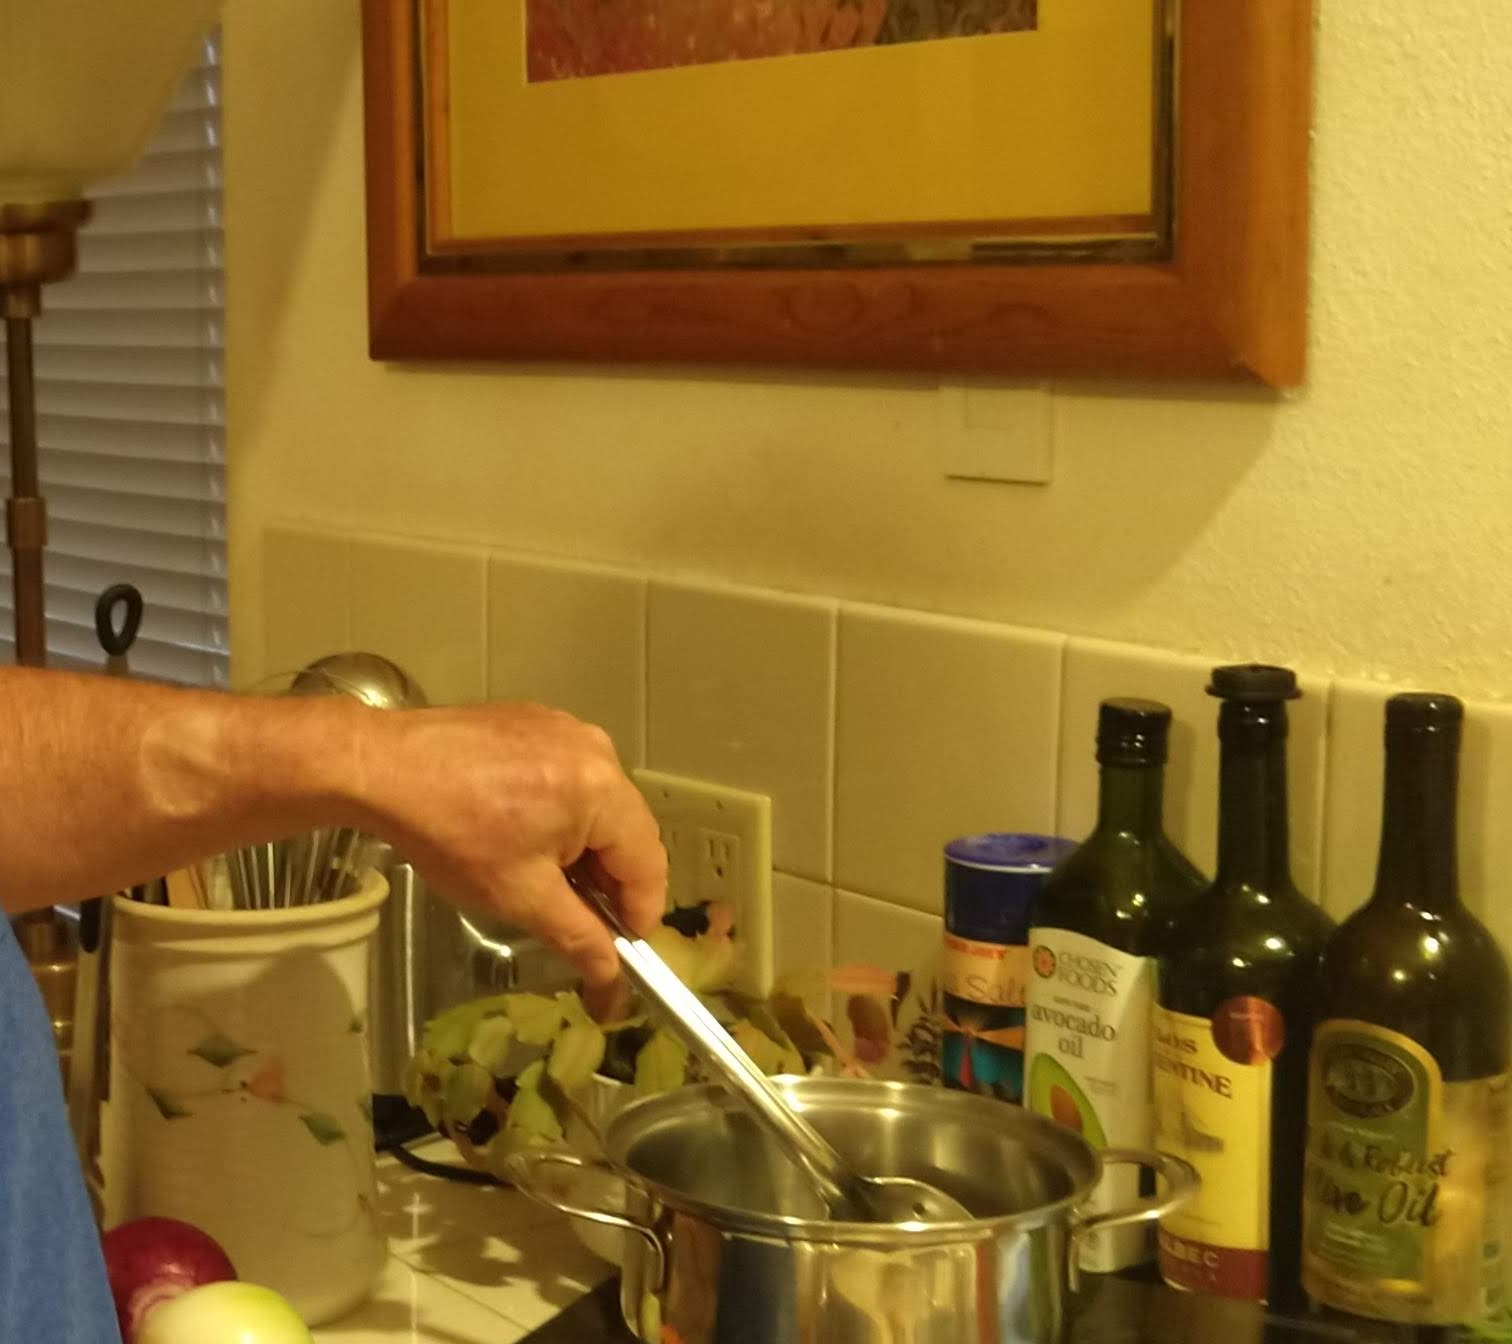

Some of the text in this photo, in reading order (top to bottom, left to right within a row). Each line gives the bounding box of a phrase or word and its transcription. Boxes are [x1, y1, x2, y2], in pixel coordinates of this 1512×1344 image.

[1058, 965, 1118, 997] FOODS
[1030, 1004, 1116, 1042] avocado
[1057, 1034, 1083, 1059] oil
[1377, 1180, 1441, 1227] Oil
